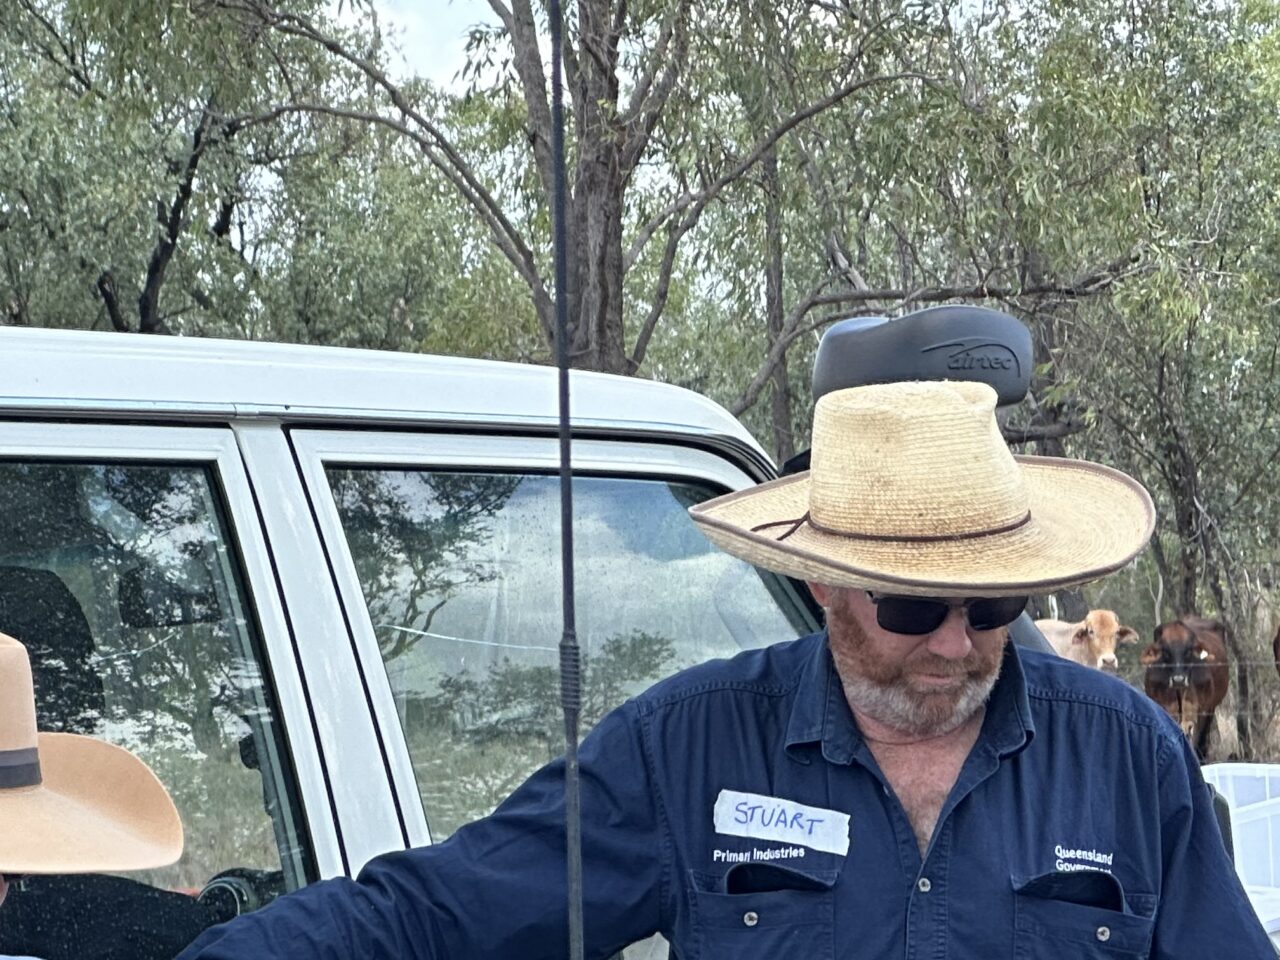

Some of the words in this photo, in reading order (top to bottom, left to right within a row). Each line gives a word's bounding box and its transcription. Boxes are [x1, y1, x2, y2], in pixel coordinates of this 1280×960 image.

[734, 801, 824, 836] STUART
[753, 847, 805, 861] Industries
[1055, 845, 1113, 865] Queensland
[1056, 859, 1112, 874] Gover
